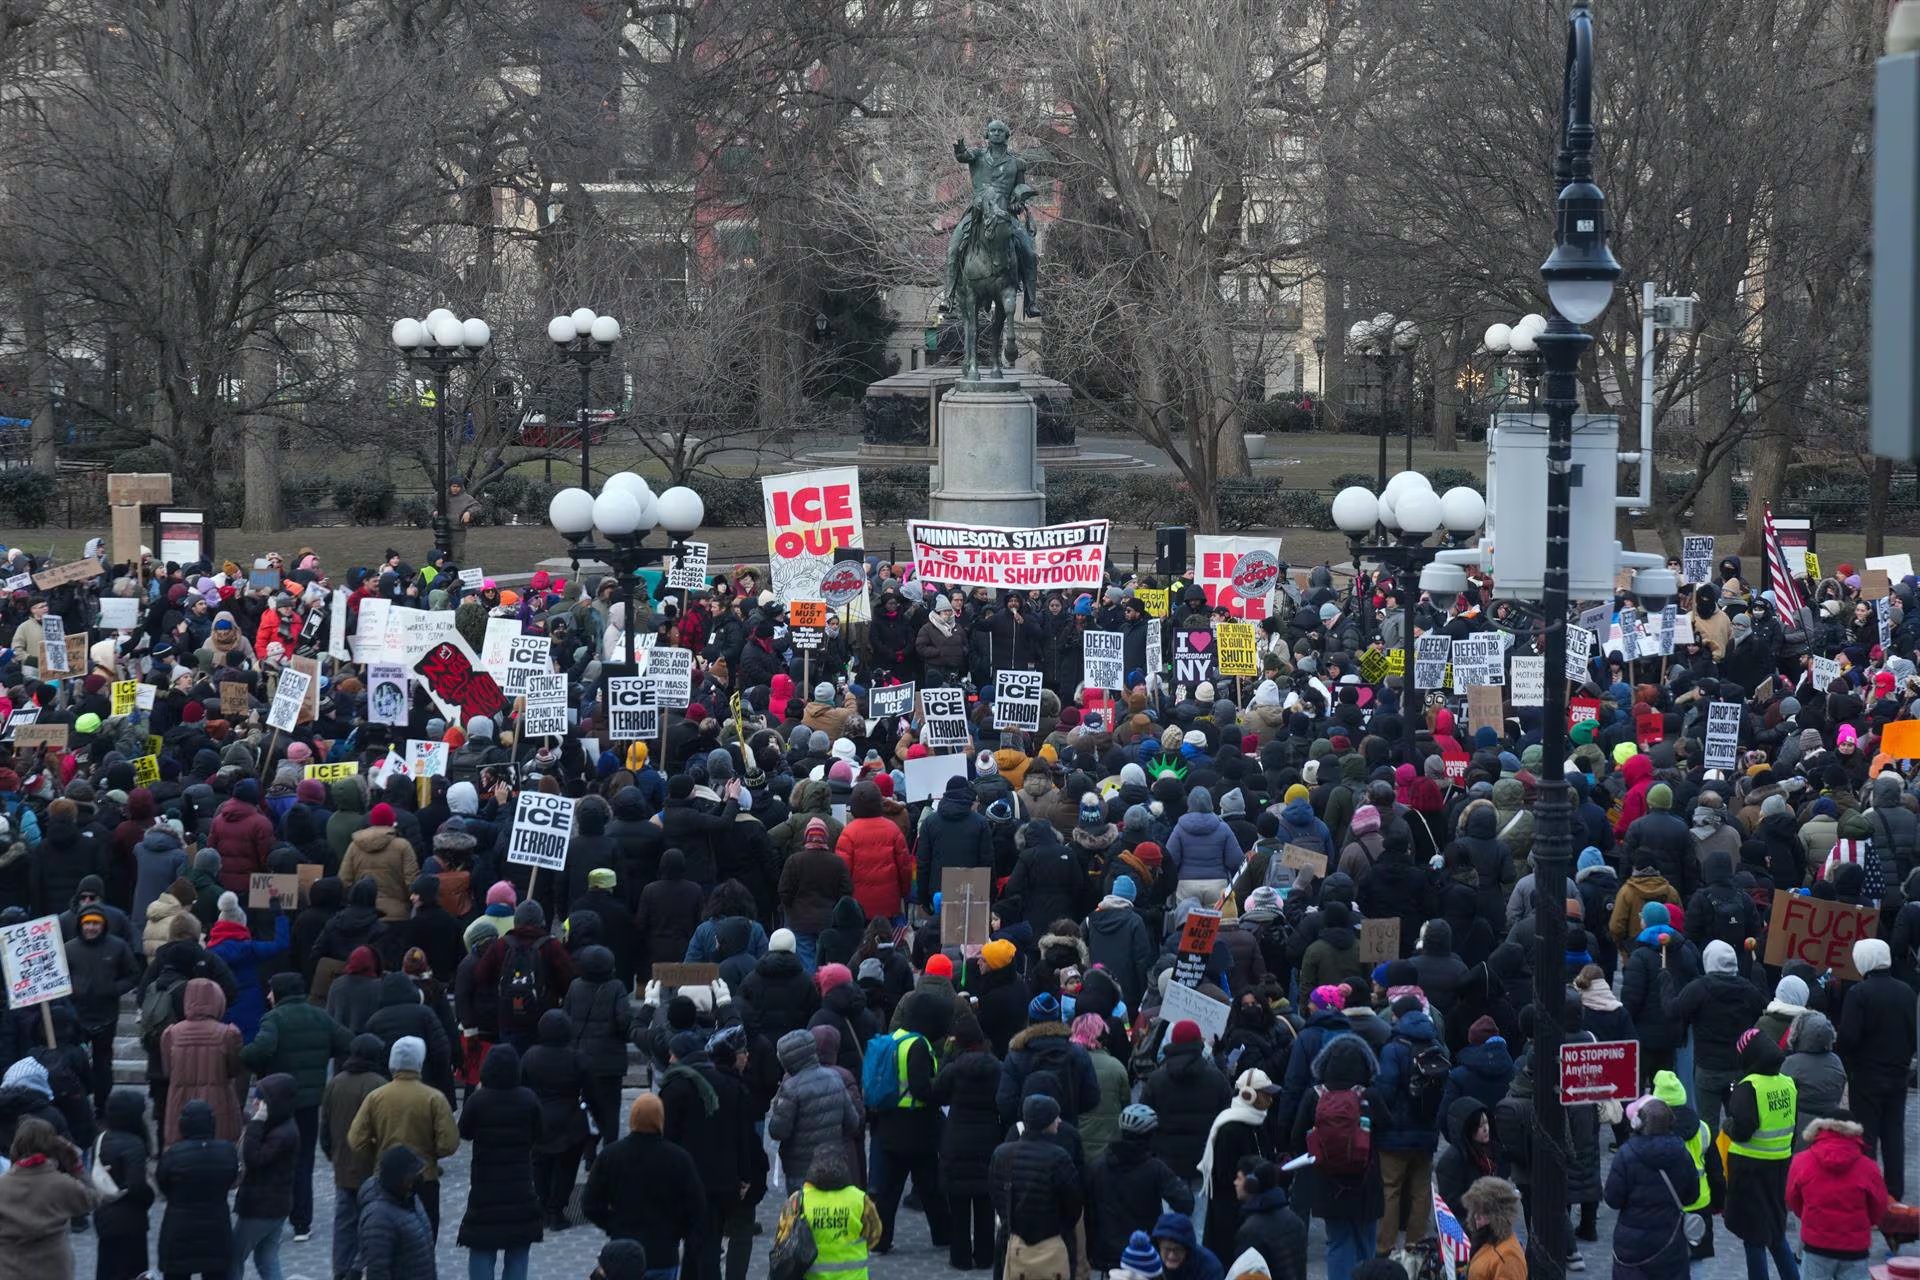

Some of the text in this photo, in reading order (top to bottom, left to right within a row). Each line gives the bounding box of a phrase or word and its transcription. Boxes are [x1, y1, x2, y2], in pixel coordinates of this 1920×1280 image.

[772, 484, 853, 526] ICE
[774, 525, 855, 559] OUT
[916, 525, 1104, 549] MINNESOTA STARTED IT
[1686, 538, 1713, 550] DEFEND
[671, 556, 705, 565] FERA
[918, 545, 1102, 565] T'S TIME FOR A
[671, 565, 704, 573] AORA
[1204, 553, 1244, 578] EN
[1004, 563, 1101, 585] SHUTDOWN
[801, 602, 816, 610] ICE
[1144, 601, 1165, 609] OW!
[1203, 584, 1267, 620] ICE
[1220, 624, 1252, 634] THE WHOLE
[512, 638, 549, 649] STOP
[1086, 633, 1121, 650] DEFEND
[1177, 632, 1189, 653] I
[1220, 638, 1252, 649] IS GUILTY
[1420, 638, 1450, 653] DEFEND
[509, 648, 547, 664] ICE
[650, 651, 689, 660] MONEY FOR
[1085, 648, 1122, 660] DEMOCRACY:
[1221, 649, 1254, 664] SHUT IT
[1454, 642, 1487, 657] DEFEND
[650, 659, 689, 668] JOBS AND
[1086, 660, 1098, 669] IT'S
[1454, 655, 1487, 666] DEMOCRACY:
[1176, 660, 1212, 681] NY
[1455, 667, 1466, 676] IT'S
[530, 676, 563, 691] STRIKE!
[611, 680, 656, 690] STOP
[665, 680, 688, 689] MASS
[999, 673, 1040, 684] STOP
[117, 681, 137, 695] ICE
[998, 683, 1040, 700] ICE
[611, 691, 656, 706] ICE
[874, 688, 911, 704] ABOLISH
[923, 692, 960, 701] STOP
[528, 706, 565, 719] EXPAND THE
[925, 702, 963, 716] ICE
[997, 702, 1038, 723] TERROR
[1710, 705, 1740, 721] DROP THE
[528, 718, 566, 734] GENERAL
[611, 710, 656, 731] TERROR
[927, 720, 967, 739] TERROR
[312, 764, 340, 778] ICE
[521, 795, 572, 811] STOP
[518, 806, 570, 831] ICE
[513, 828, 566, 859] TERROR
[252, 876, 273, 889] NYC
[1782, 899, 1875, 941] FUCK
[30, 921, 53, 935] OUT
[1787, 933, 1849, 968] ICE
[1565, 1048, 1625, 1062] NO STOPPING
[1565, 1063, 1603, 1077] Anytime
[1769, 1097, 1792, 1112] RESIST
[813, 1207, 849, 1216] RISE AND
[812, 1216, 848, 1229] RESIST
